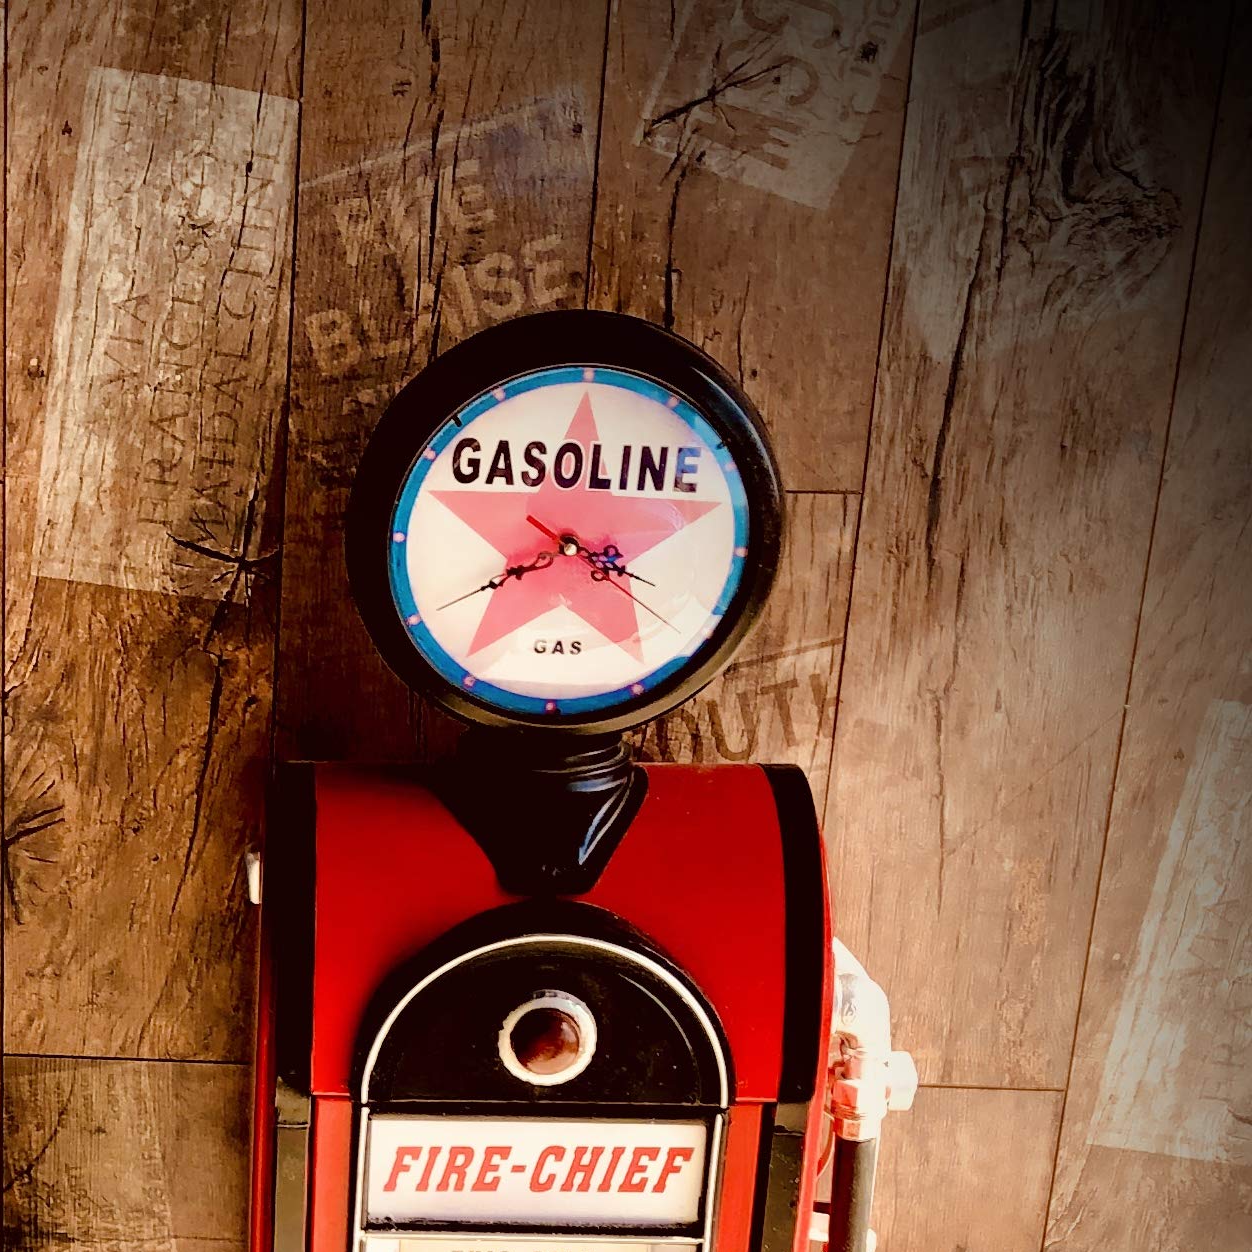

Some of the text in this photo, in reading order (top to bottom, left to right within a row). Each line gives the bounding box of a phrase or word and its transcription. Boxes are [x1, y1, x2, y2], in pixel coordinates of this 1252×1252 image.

[451, 436, 702, 494] GASOLINE
[533, 640, 583, 656] GAS
[383, 1144, 695, 1194] FIRE-CHIEF
